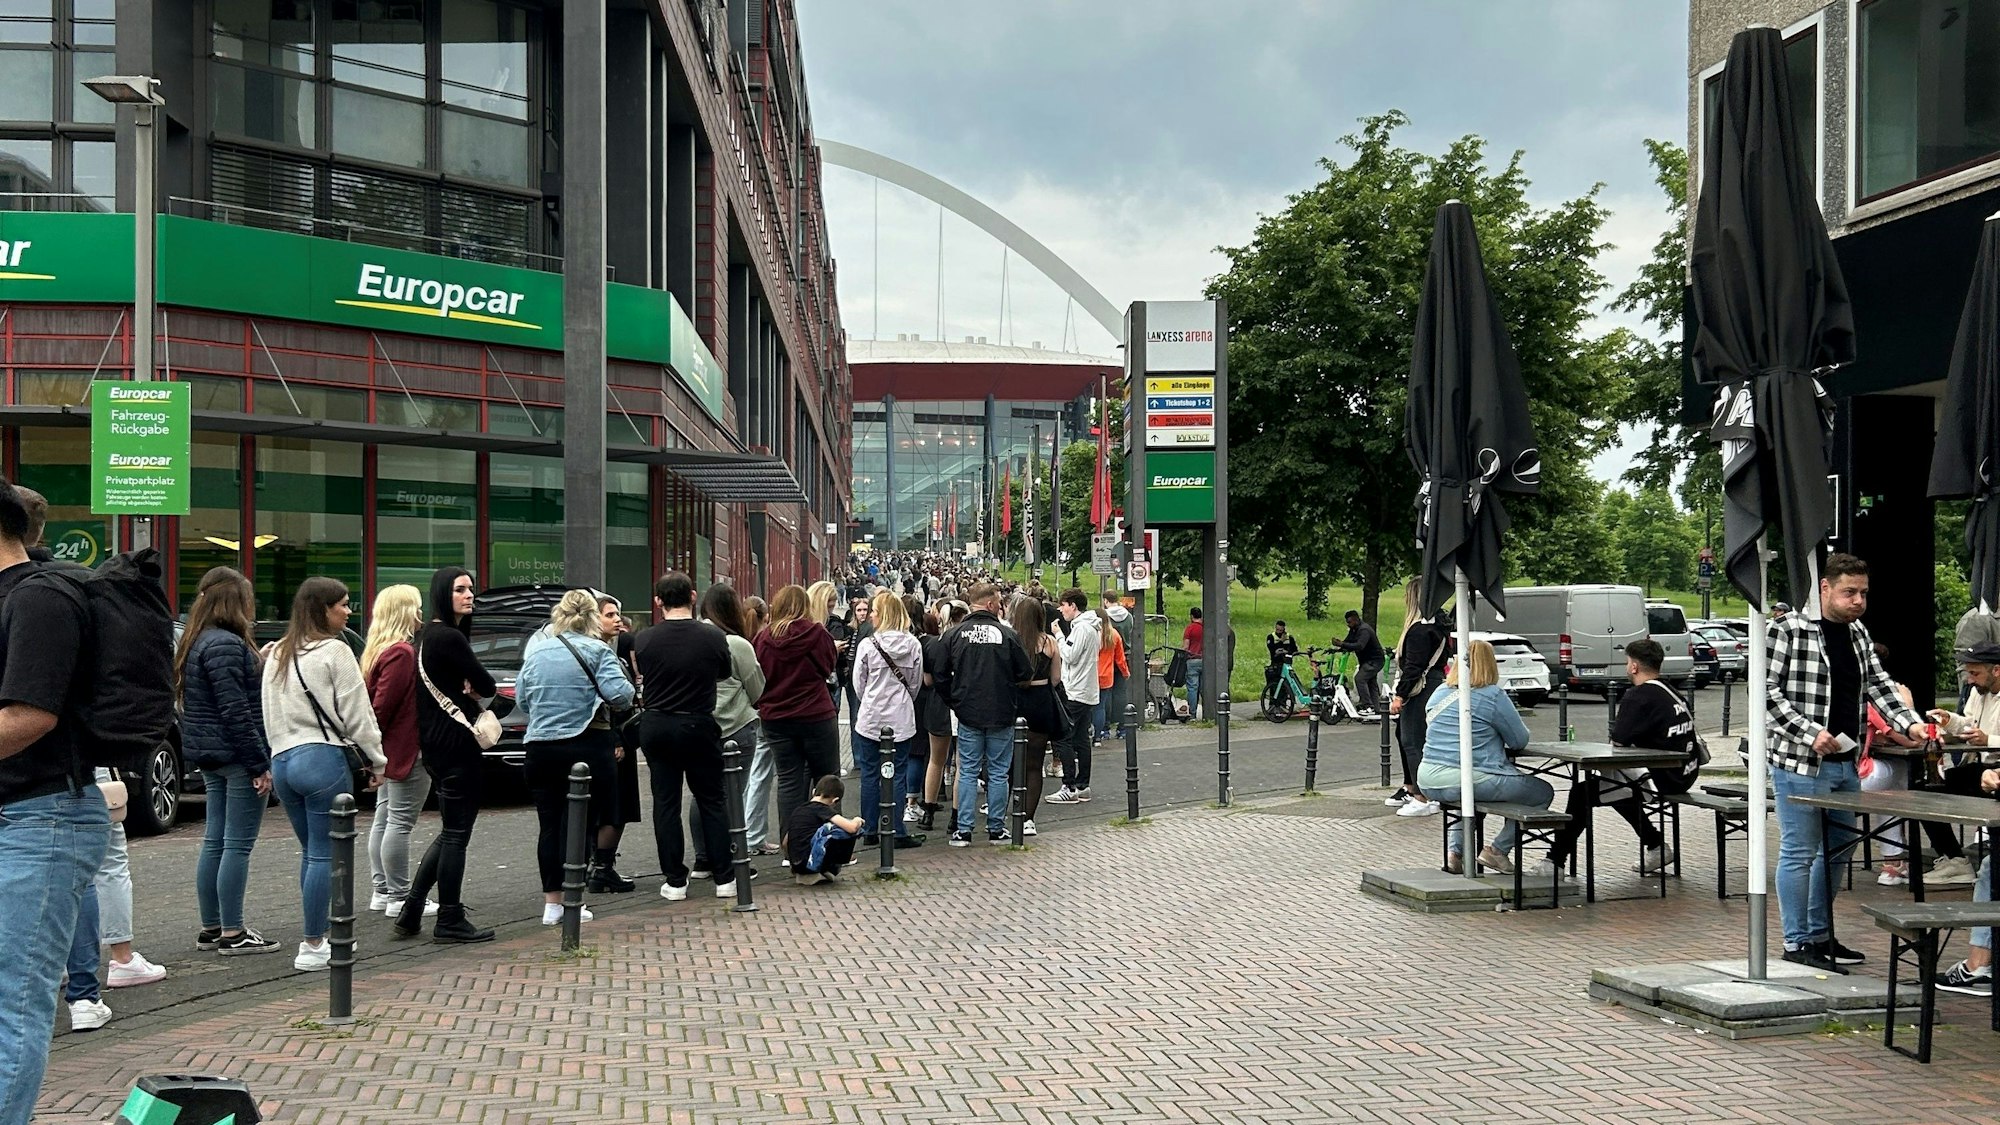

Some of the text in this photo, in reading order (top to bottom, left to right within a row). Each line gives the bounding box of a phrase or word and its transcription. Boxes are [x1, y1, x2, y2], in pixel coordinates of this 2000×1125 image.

[357, 263, 525, 318] Europcar
[1147, 331, 1213, 343] LANXESS arena
[110, 387, 172, 401] Europcar
[1165, 399, 1197, 408] Ticketshop
[111, 409, 170, 424] Fahrzeug-
[111, 423, 170, 437] Rückgabe
[109, 454, 172, 468] Europcar
[105, 475, 175, 487] Privatparkplatz
[1153, 475, 1208, 488] Europcar
[396, 490, 457, 505] Europcar
[508, 557, 531, 570] Uns
[509, 575, 531, 585] was
[533, 572, 550, 585] Sie
[961, 630, 989, 639] NORTH
[973, 624, 989, 632] THE
